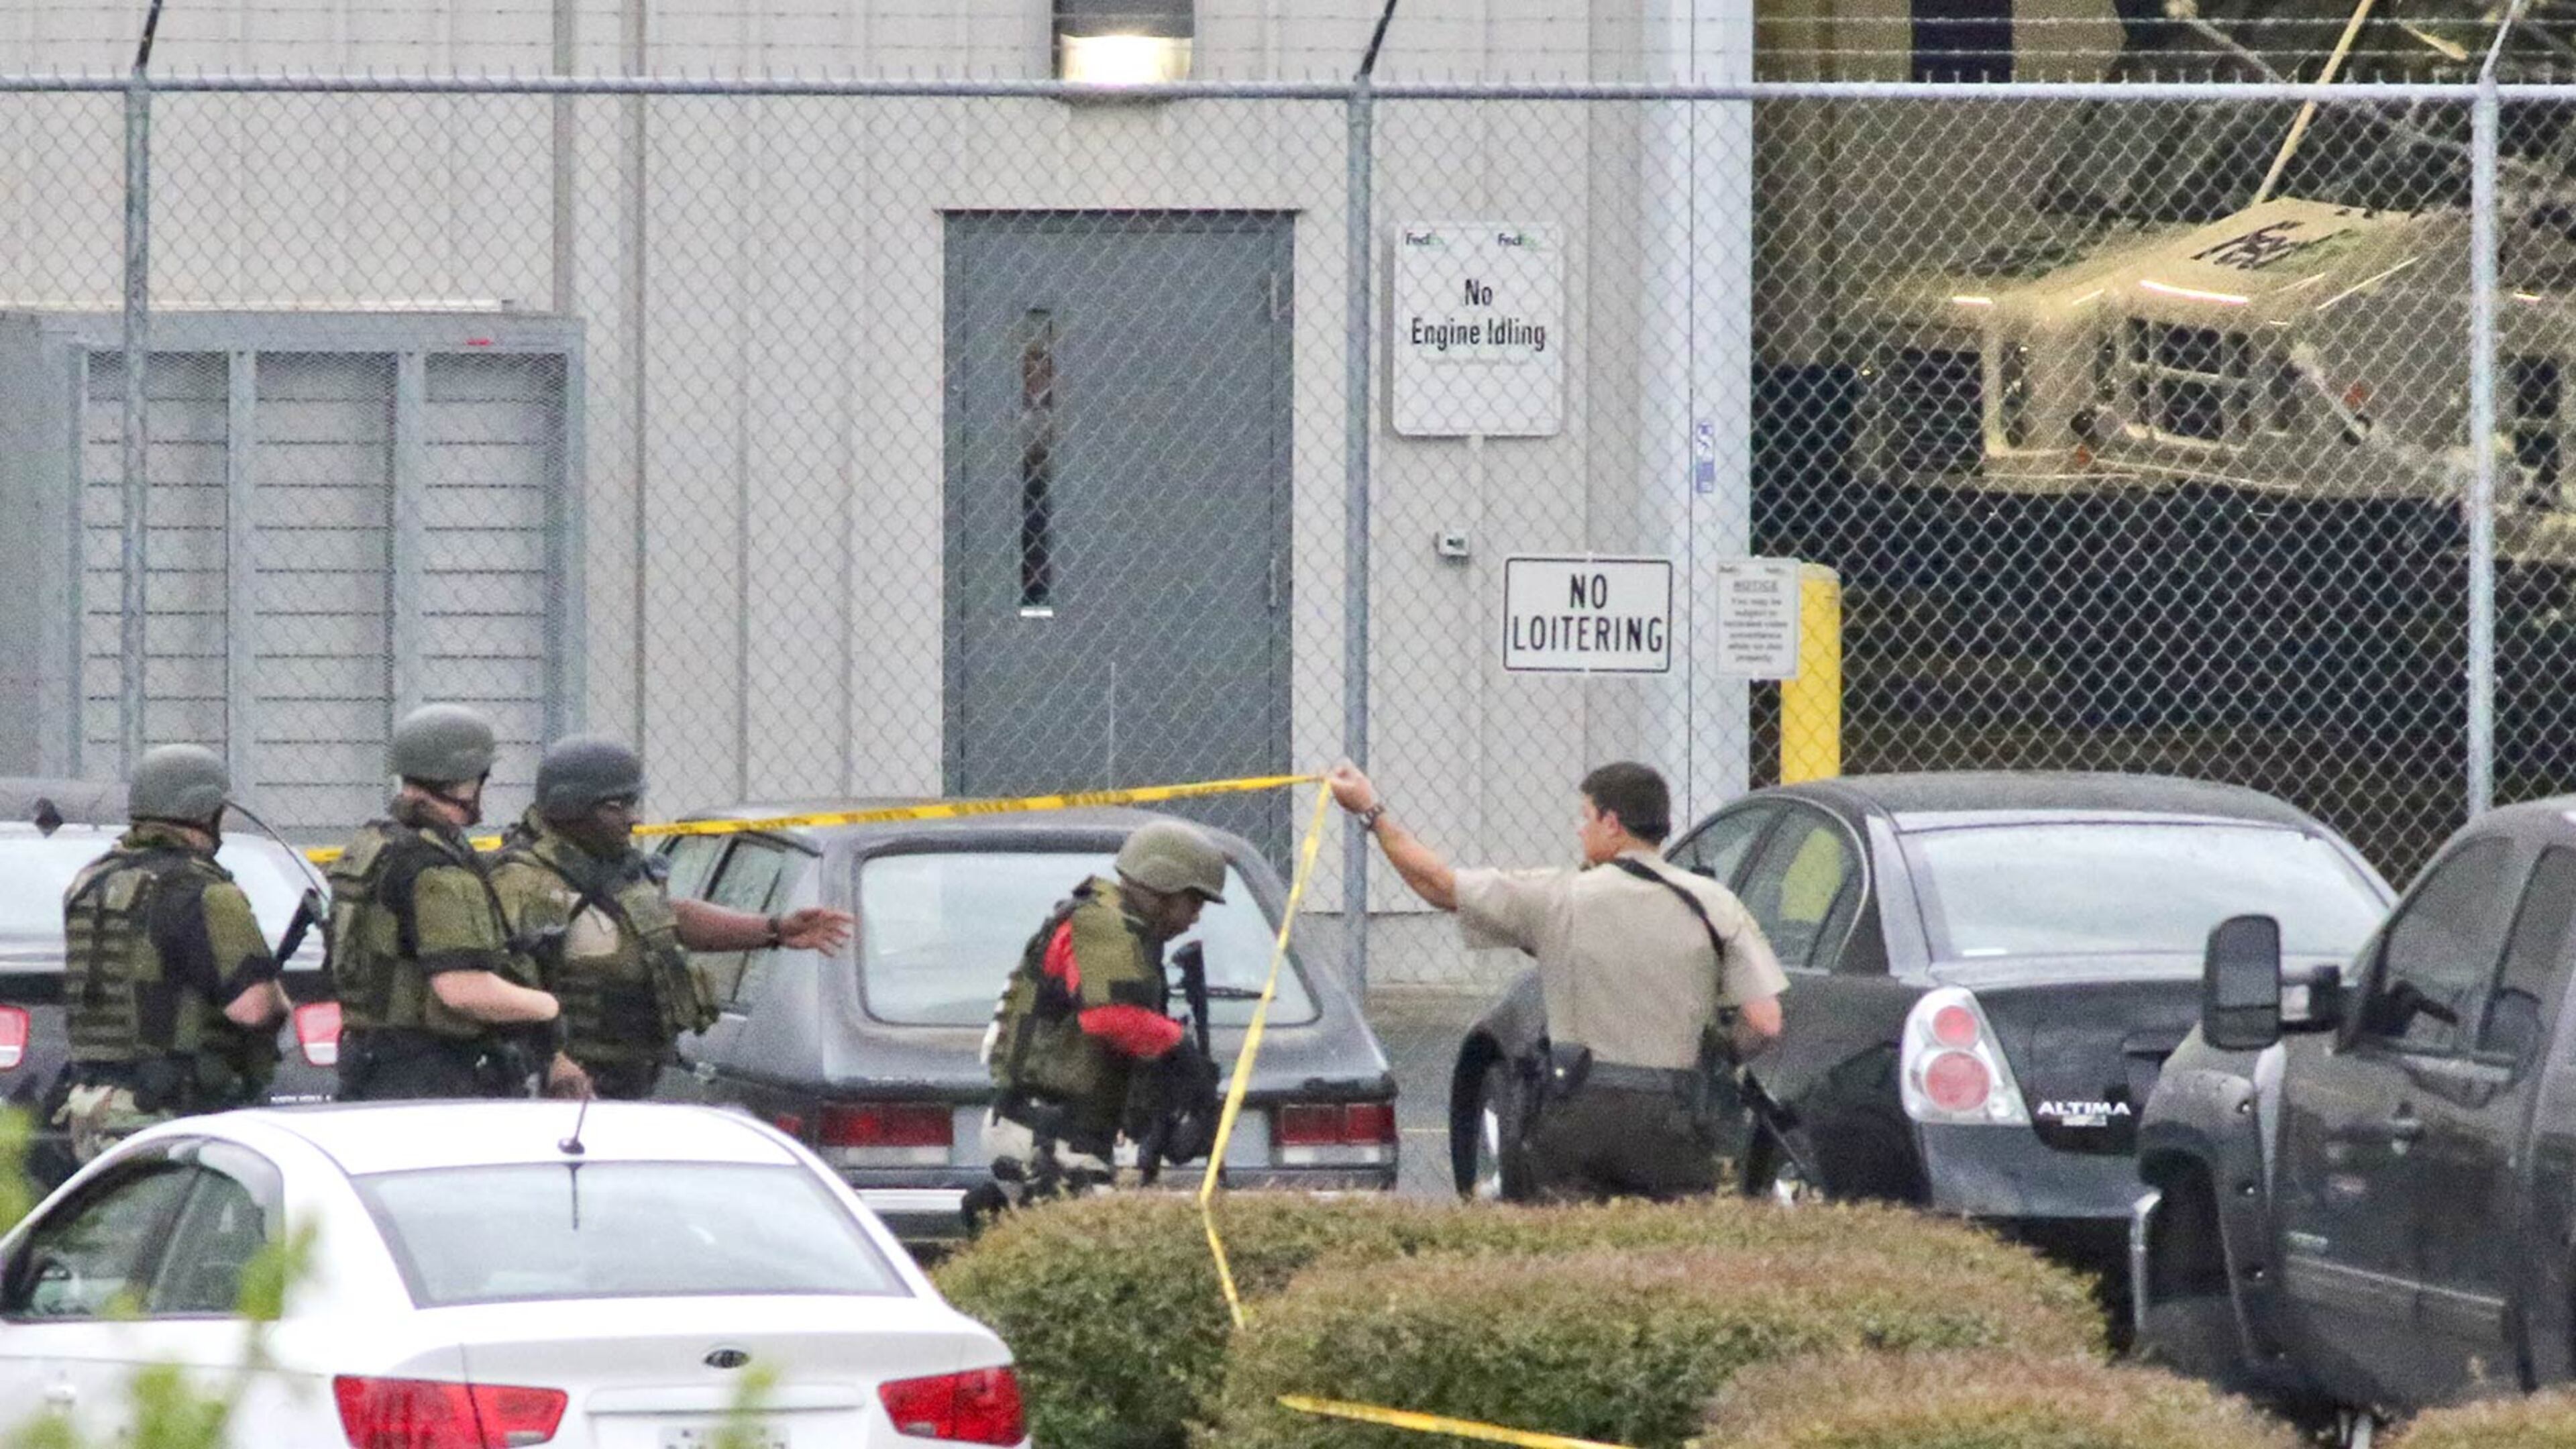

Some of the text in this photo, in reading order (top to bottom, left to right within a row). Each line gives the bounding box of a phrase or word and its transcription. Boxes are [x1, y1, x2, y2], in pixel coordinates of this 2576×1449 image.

[1465, 278, 1493, 306] No
[1411, 317, 1546, 352] Engine Idling
[1570, 574, 1607, 609] NO
[1513, 615, 1663, 653] LOITERING
[2037, 1101, 2131, 1116] ALTIMA
